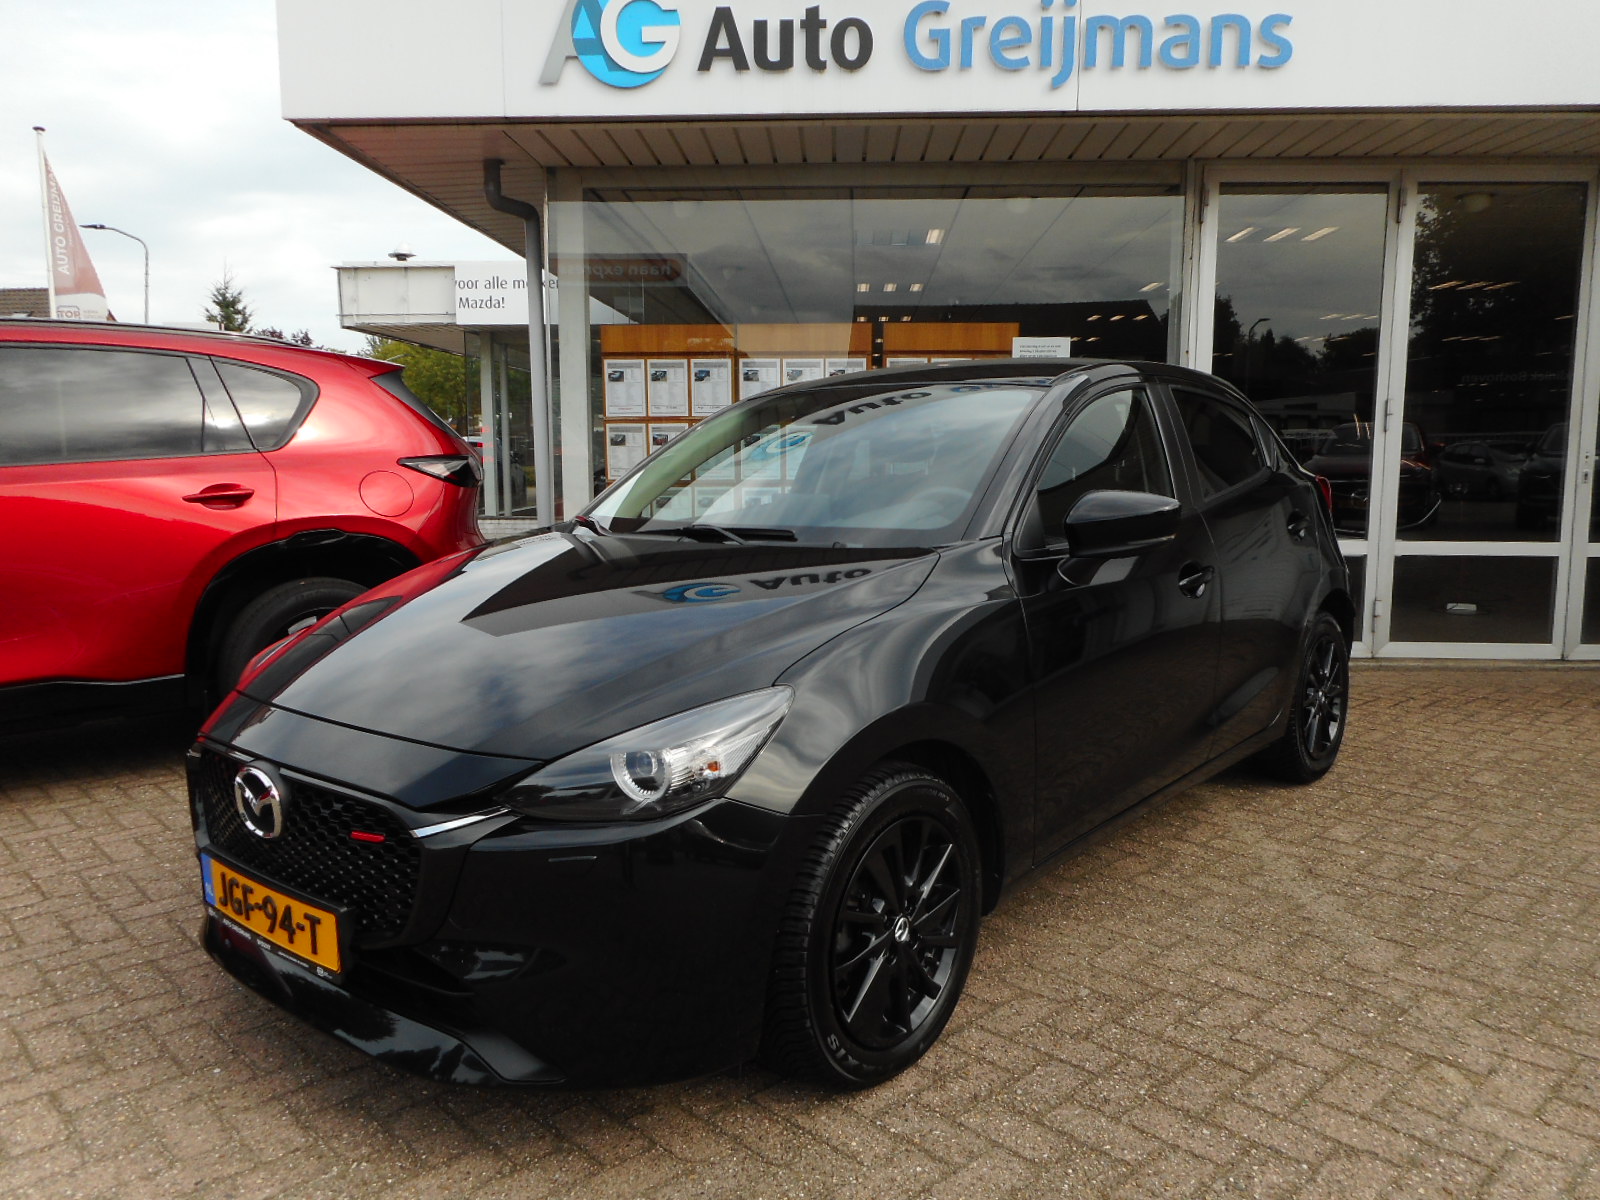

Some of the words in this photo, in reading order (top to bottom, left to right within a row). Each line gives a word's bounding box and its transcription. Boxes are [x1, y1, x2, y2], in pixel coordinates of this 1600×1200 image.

[697, 5, 874, 72] Auto
[903, 0, 1293, 90] Greijmans
[56, 237, 71, 275] AUTO
[484, 276, 508, 290] alle
[458, 296, 505, 309] Mazda!
[219, 871, 322, 955] JGF-94-T
